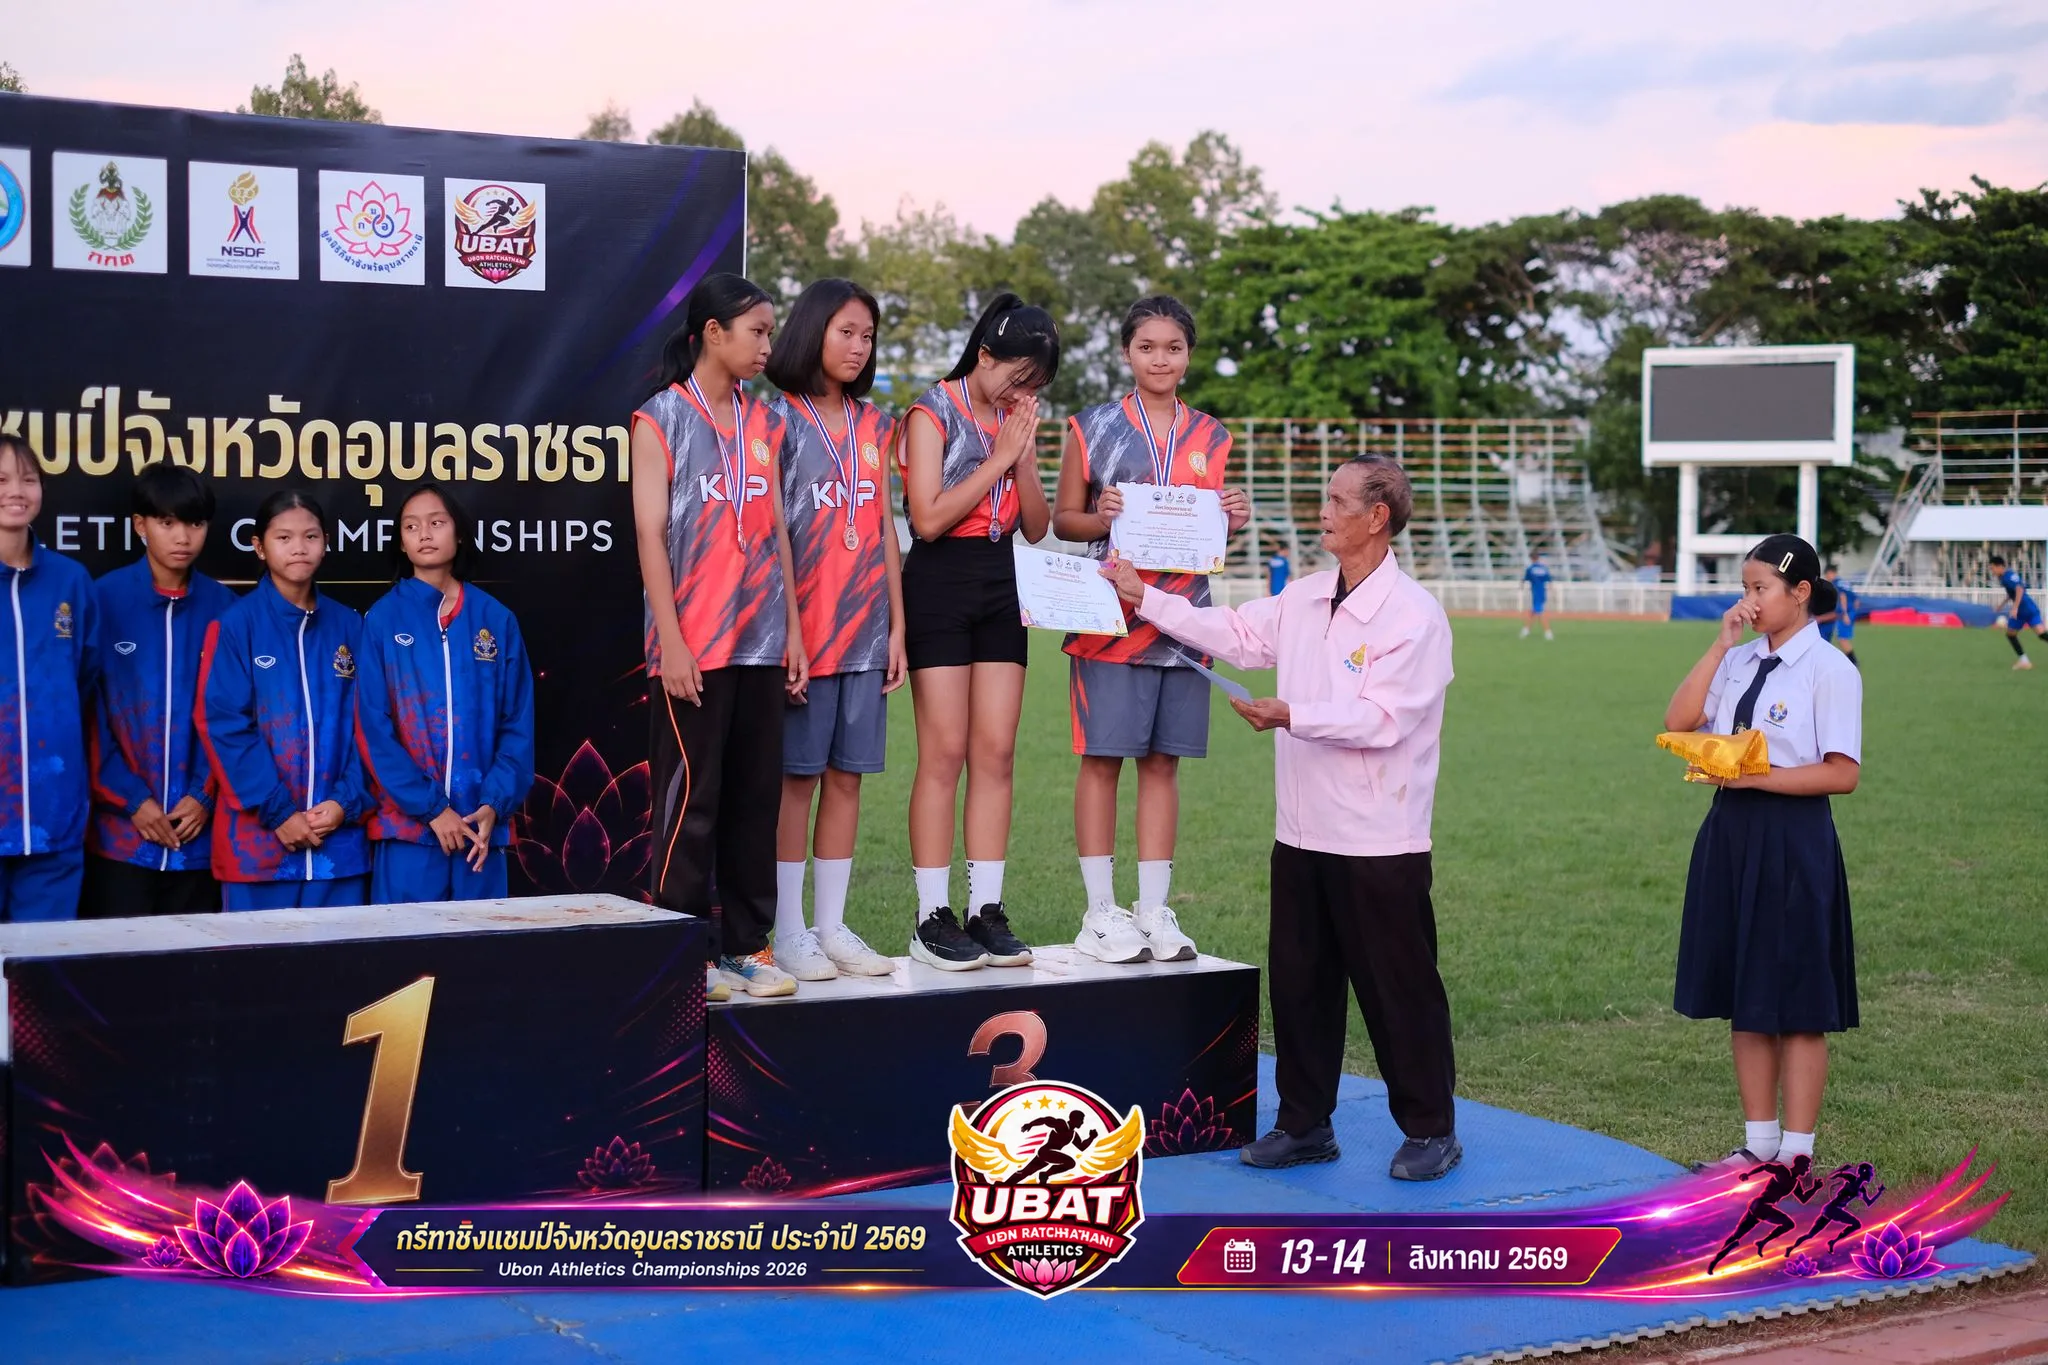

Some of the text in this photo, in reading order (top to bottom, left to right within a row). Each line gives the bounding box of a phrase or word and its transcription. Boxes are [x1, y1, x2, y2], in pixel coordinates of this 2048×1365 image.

[221, 246, 266, 258] NSDF
[461, 234, 530, 256] UBAT
[324, 976, 435, 1204] 1
